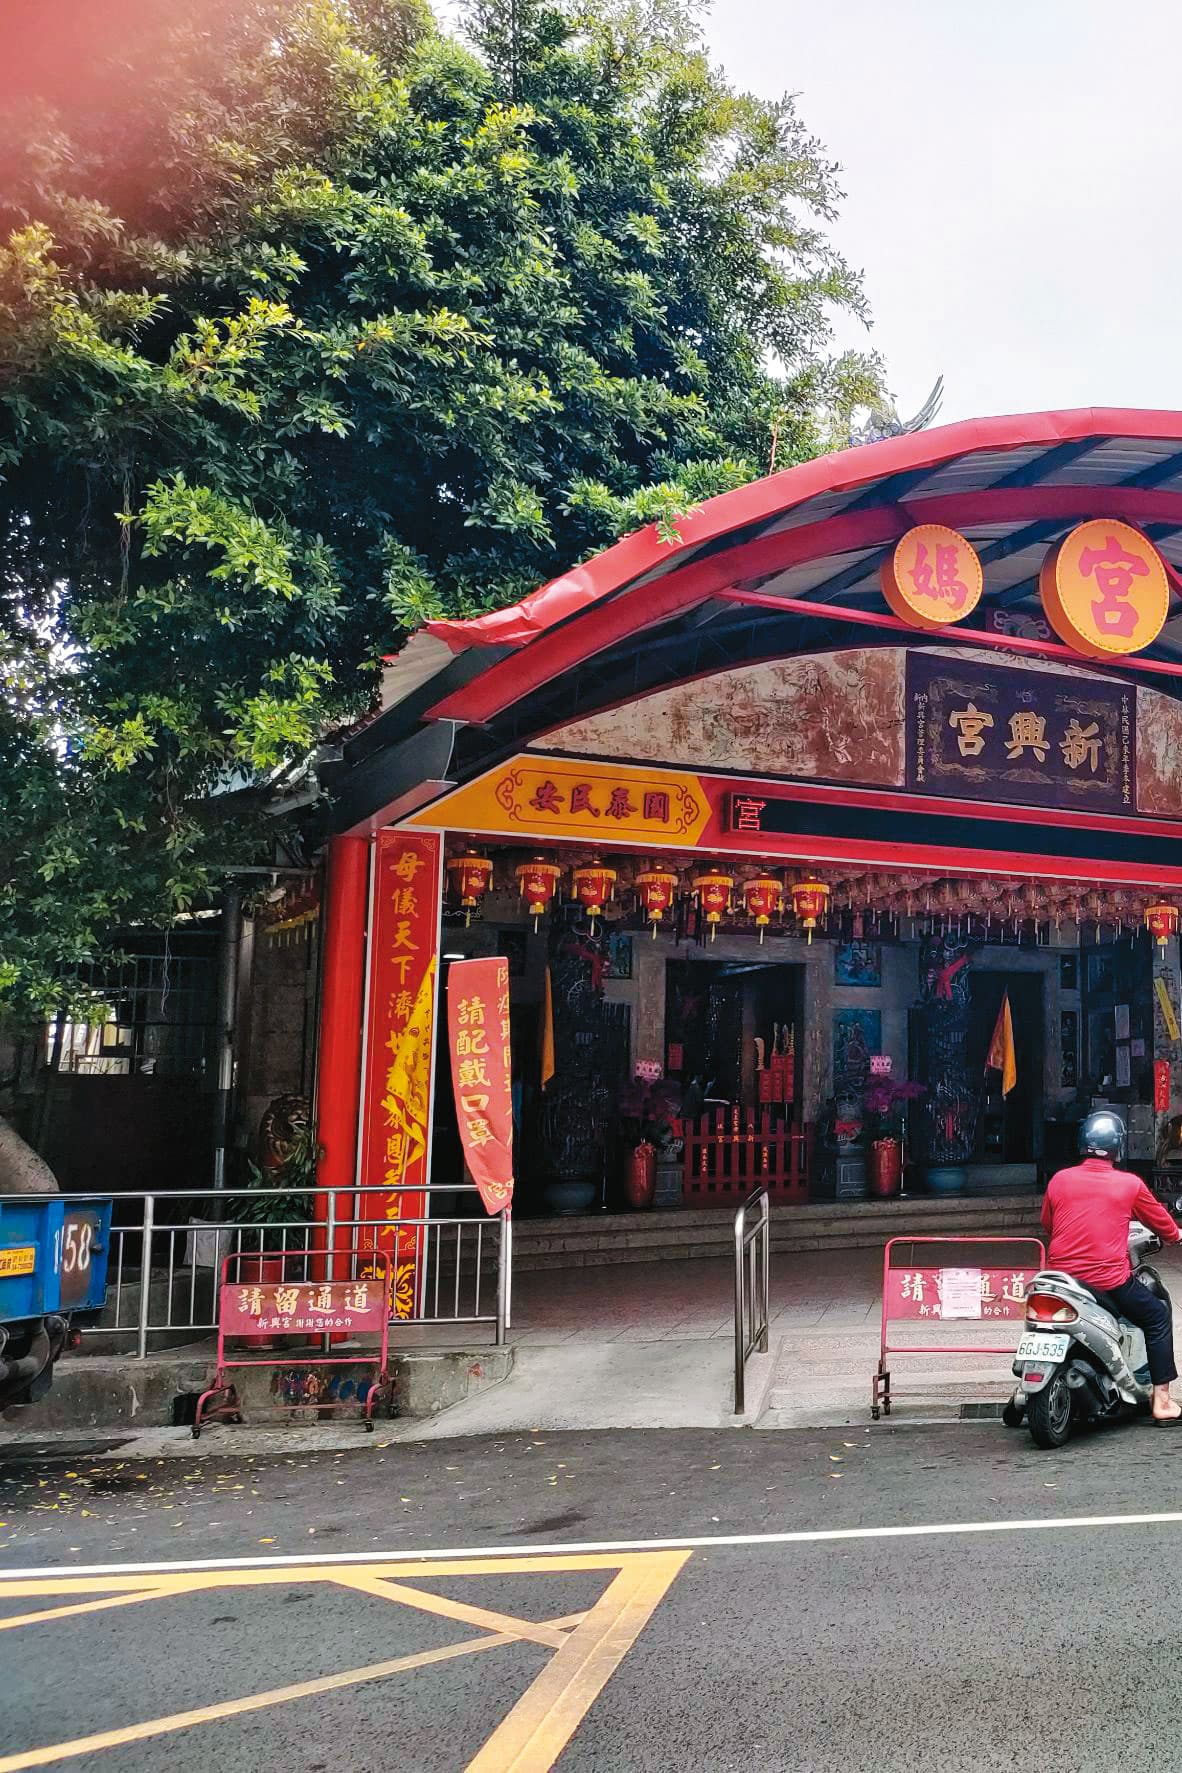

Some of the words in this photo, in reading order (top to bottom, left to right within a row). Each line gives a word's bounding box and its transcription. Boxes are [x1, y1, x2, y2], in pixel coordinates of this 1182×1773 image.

[456, 996, 495, 1148] 請配戴口罩
[238, 1284, 372, 1315] 請留通道
[257, 1317, 292, 1329] 新興宮
